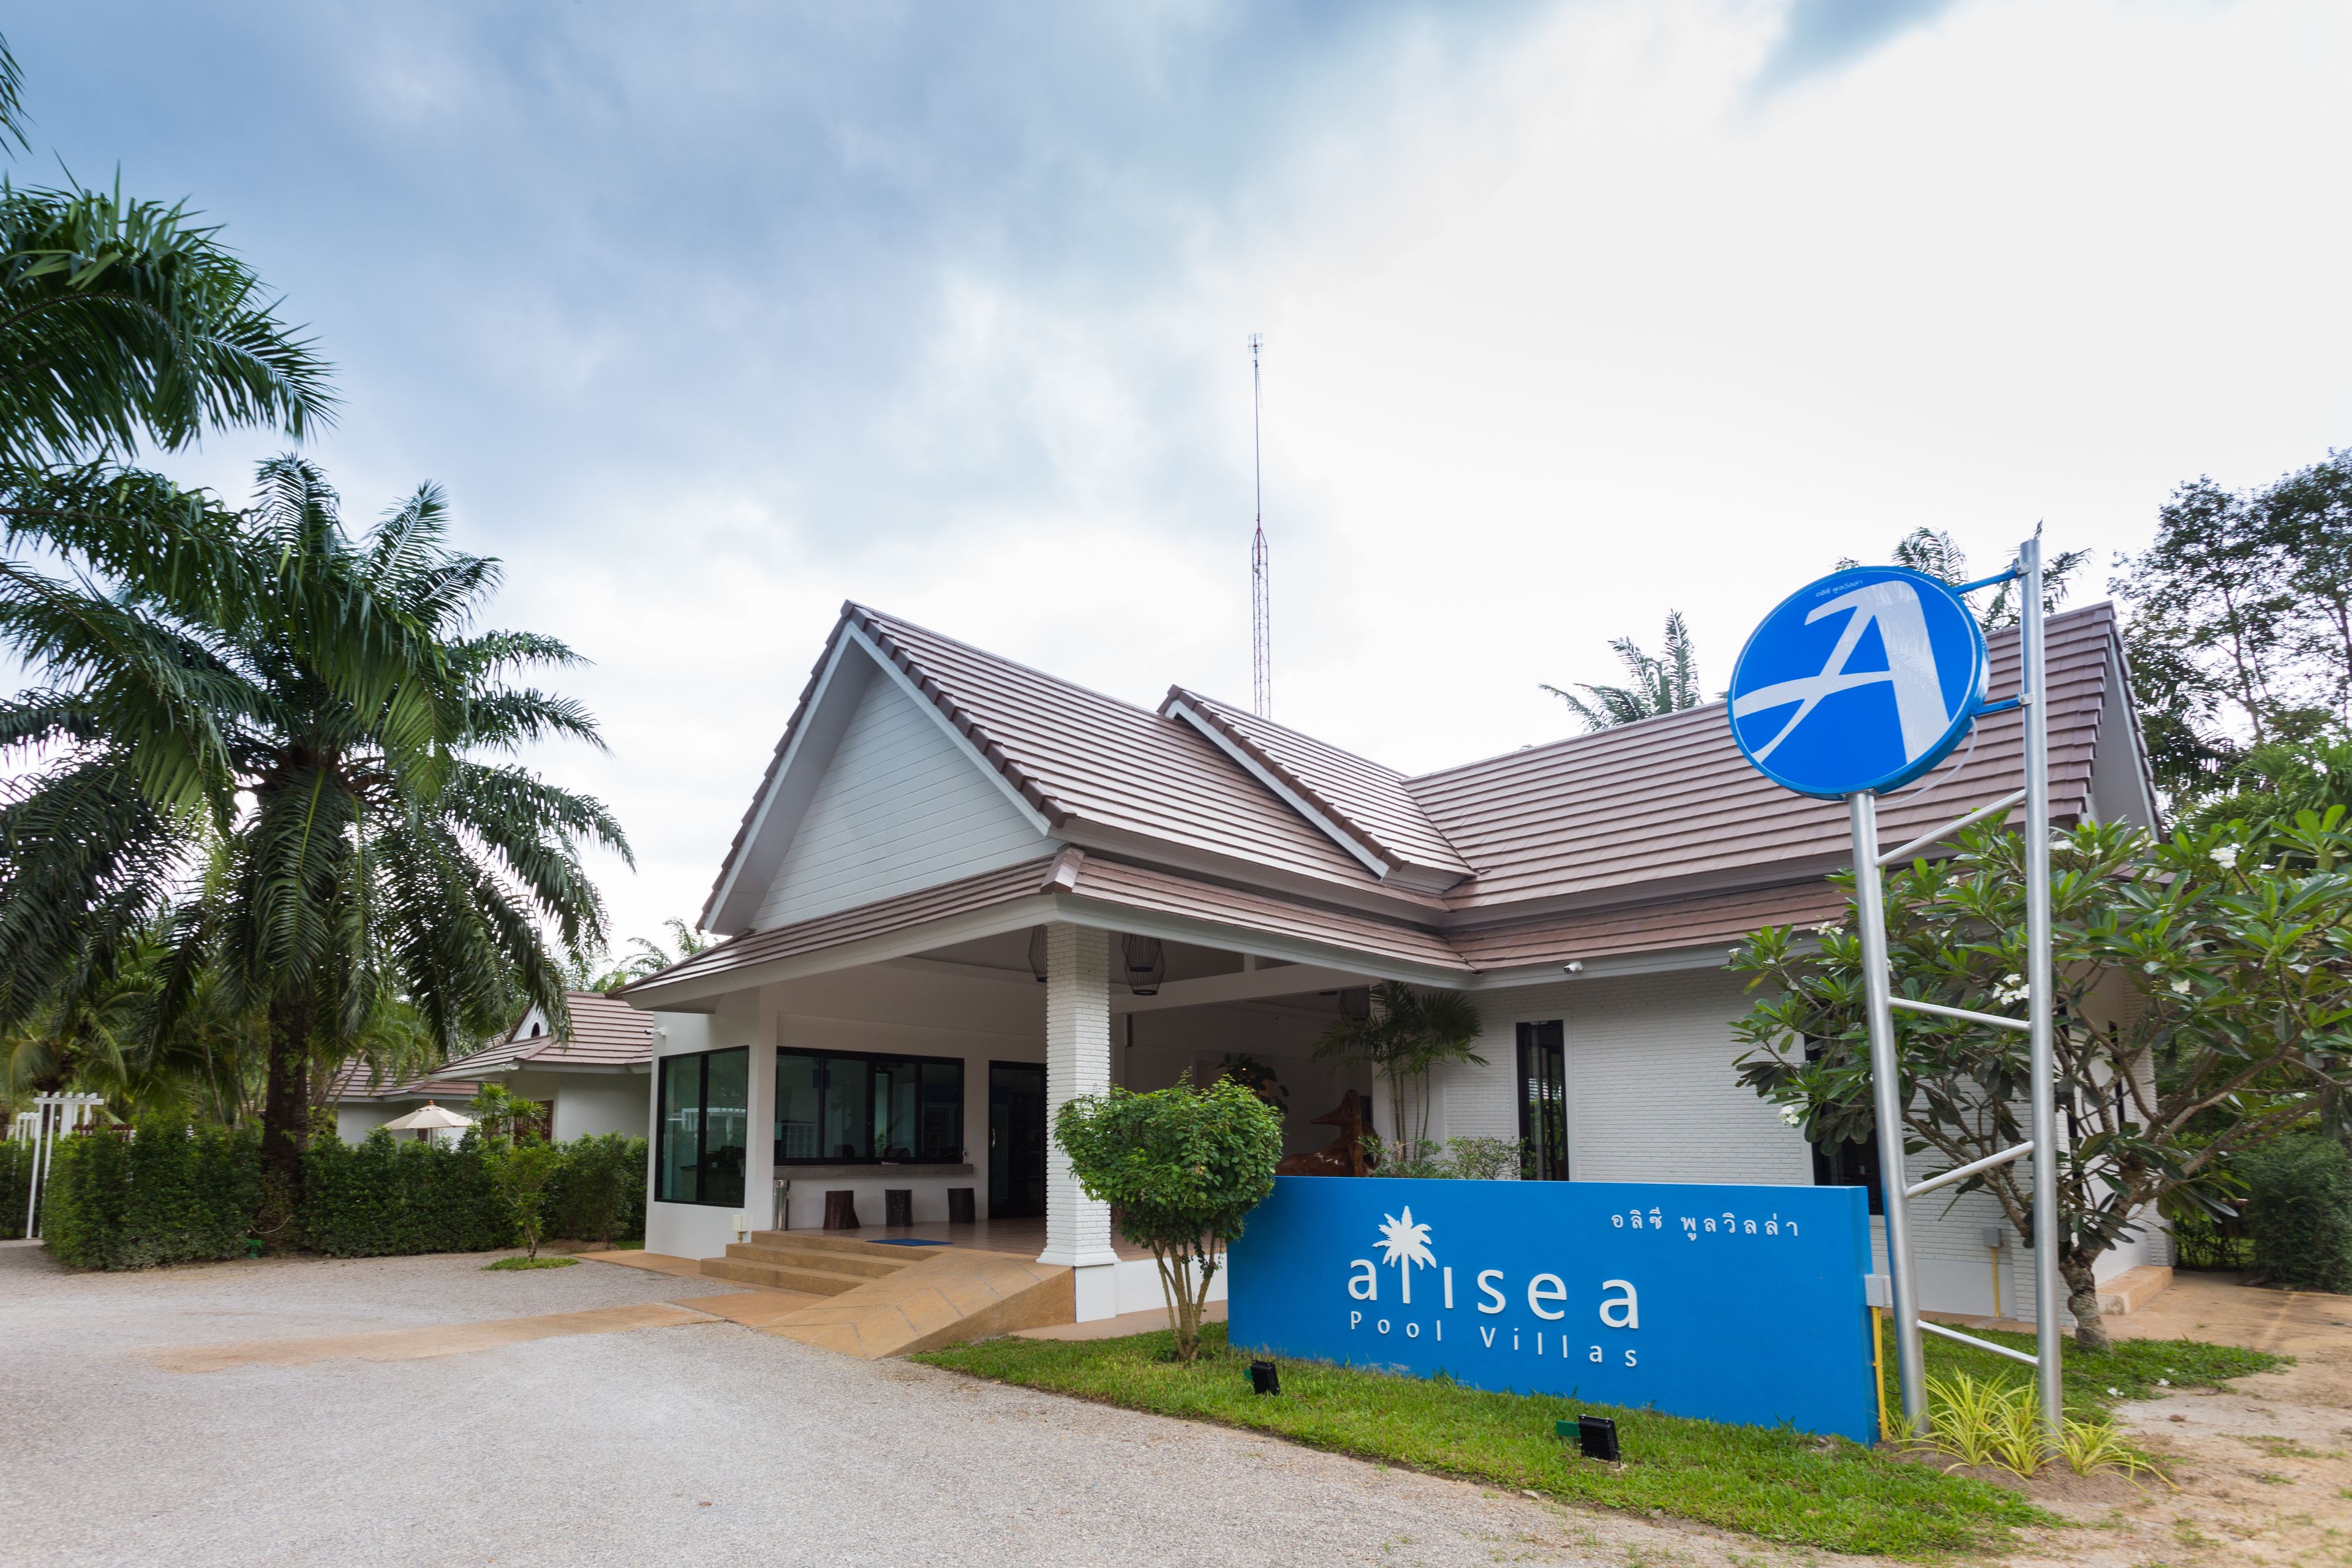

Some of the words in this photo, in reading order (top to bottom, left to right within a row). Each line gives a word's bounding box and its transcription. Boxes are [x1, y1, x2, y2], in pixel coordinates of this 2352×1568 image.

[1733, 580, 1951, 766] A
[1611, 1207, 1662, 1230] อลิซี
[1681, 1212, 1798, 1241] พูลวิลล่า
[1351, 1311, 1441, 1341] Pool
[1480, 1326, 1637, 1367] Villas
